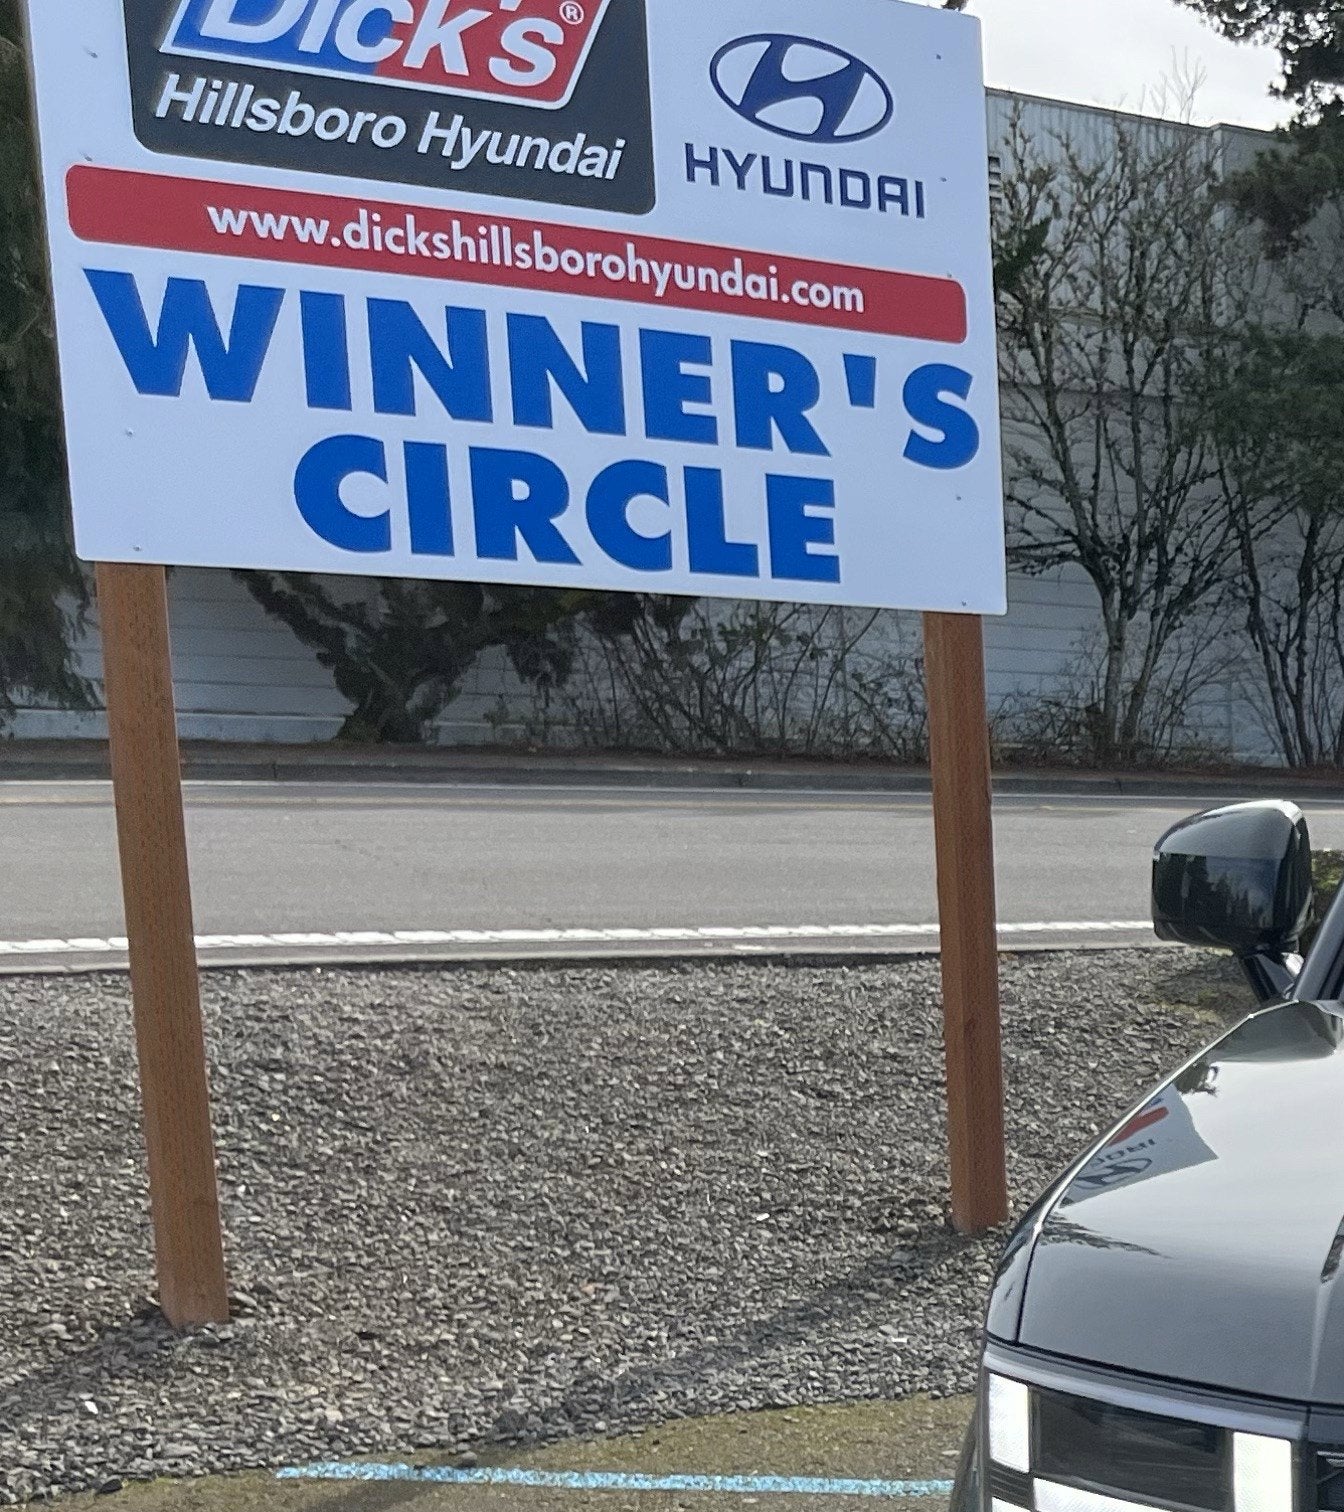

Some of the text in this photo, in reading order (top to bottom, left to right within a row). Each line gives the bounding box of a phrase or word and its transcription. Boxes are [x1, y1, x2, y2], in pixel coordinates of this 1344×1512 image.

[155, 73, 626, 181] Hillsboro Hyundai
[685, 142, 925, 219] HYUNDAI
[206, 202, 866, 316] www.dickshillsborohyundai.com
[84, 268, 980, 471] WINNER'S
[293, 434, 841, 583] CIRCLE
